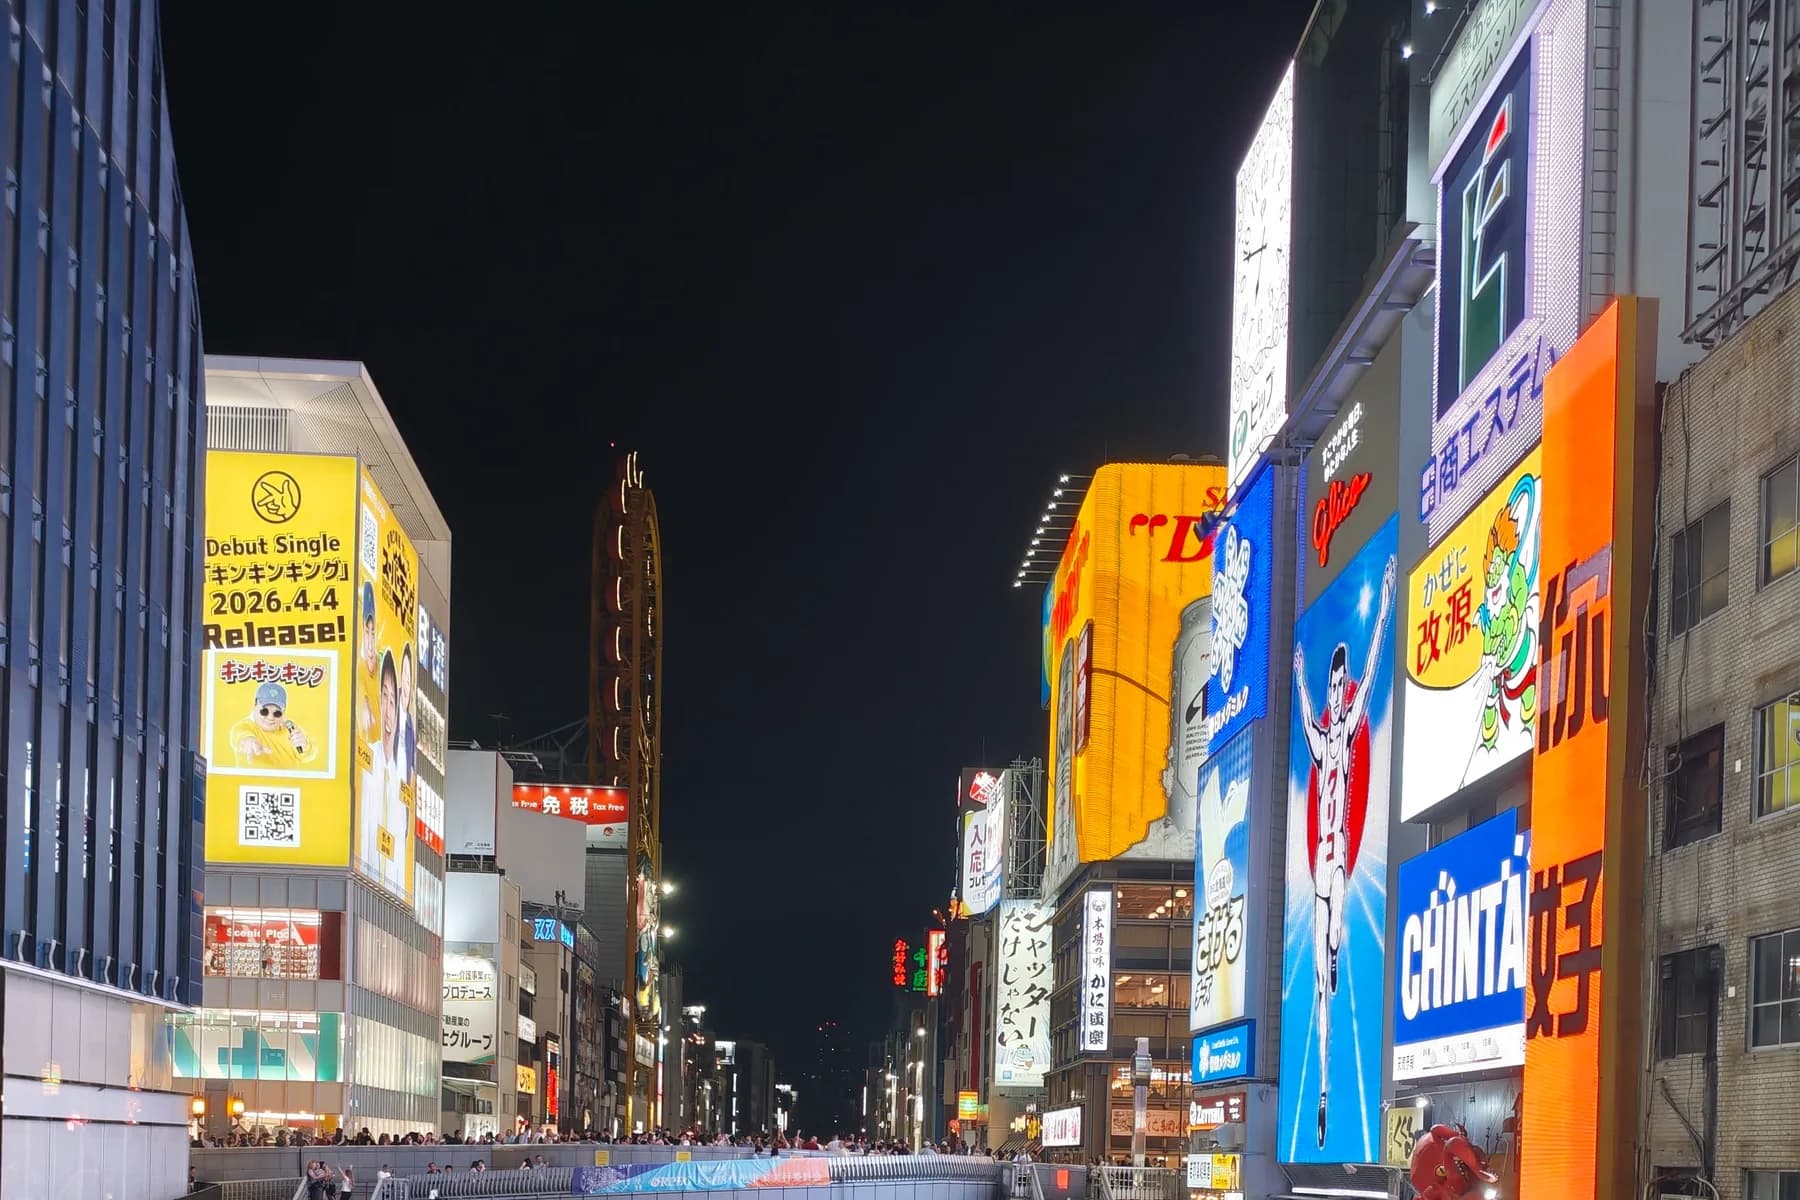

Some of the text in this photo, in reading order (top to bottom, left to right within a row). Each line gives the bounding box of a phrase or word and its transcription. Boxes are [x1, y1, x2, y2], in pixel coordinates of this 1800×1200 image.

[1312, 472, 1372, 568] Glico
[206, 534, 341, 558] Debut Single
[204, 559, 349, 586] 「キンキンキング」
[1423, 545, 1468, 608] かぜに
[211, 588, 339, 616] 2026.4.4
[203, 615, 346, 650] Release!
[1416, 575, 1474, 677] 改源
[221, 660, 325, 688] キンキンキング
[542, 795, 589, 816] 免税
[592, 803, 606, 811] Tax
[607, 803, 625, 812] Free
[1402, 834, 1530, 1020] CHINTA
[998, 906, 1029, 1048] だけじゃない
